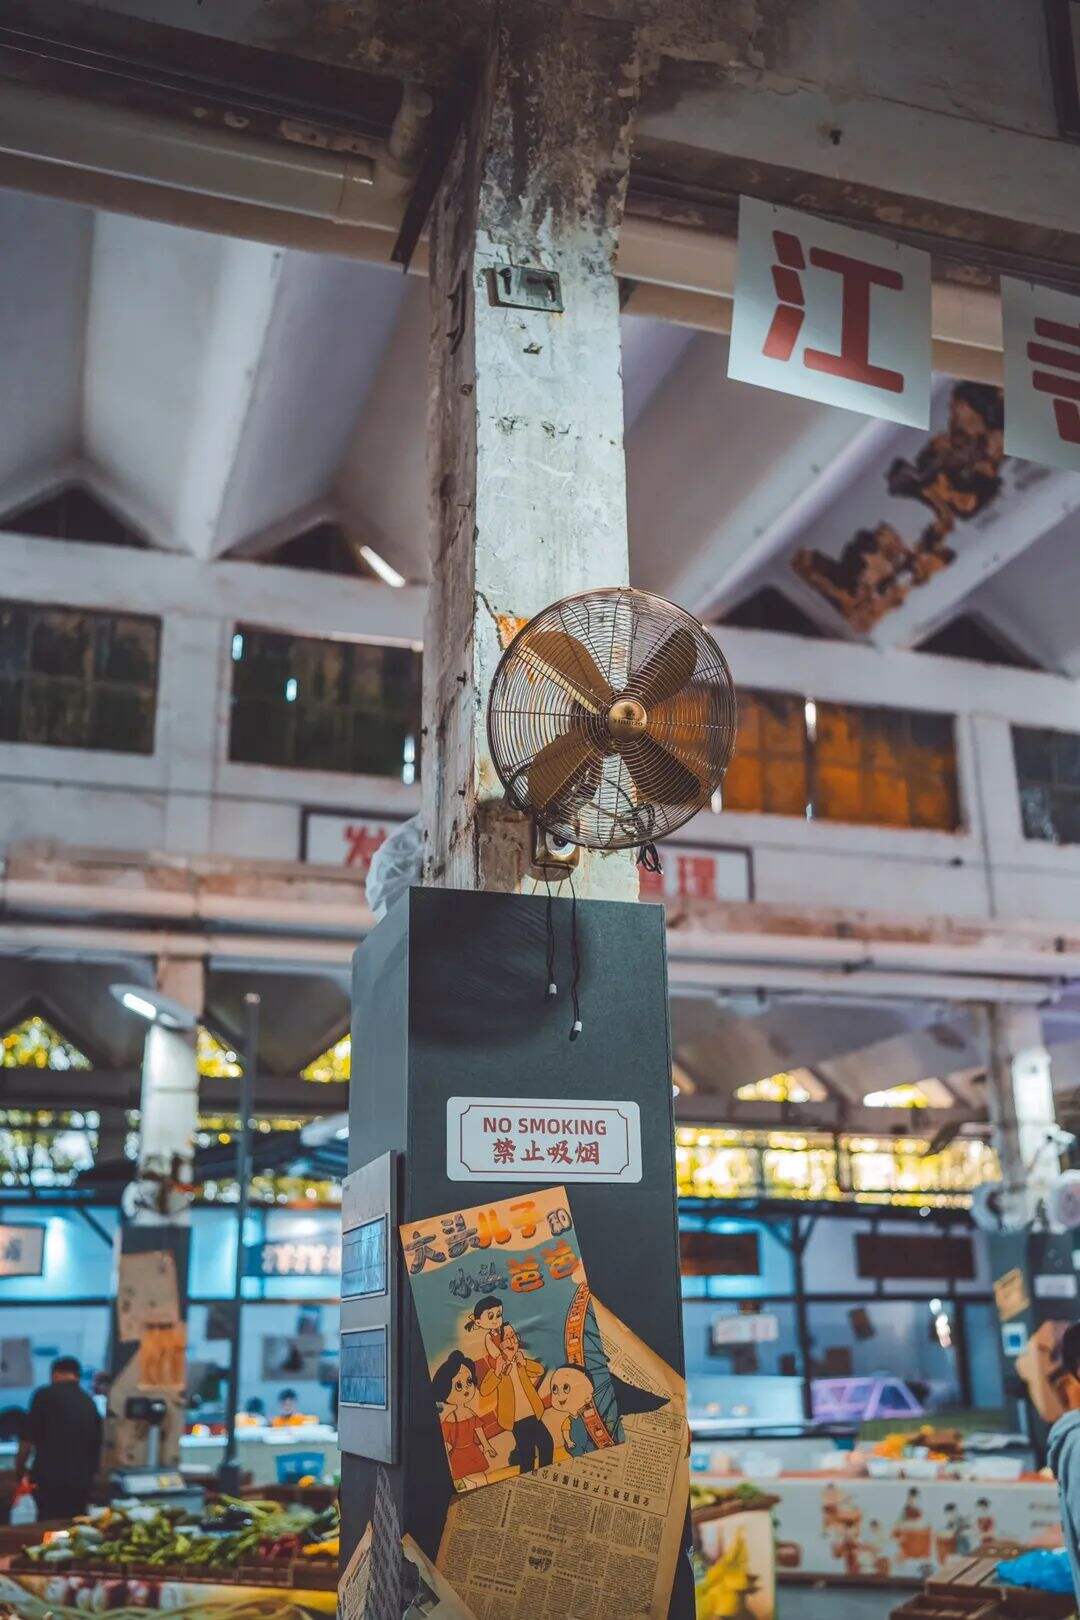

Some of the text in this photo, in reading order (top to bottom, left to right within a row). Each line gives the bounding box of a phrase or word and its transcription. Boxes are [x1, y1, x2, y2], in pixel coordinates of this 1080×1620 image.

[762, 230, 904, 394] 江
[483, 1117, 607, 1136] NO SMOKING
[492, 1137, 600, 1165] 禁止吸烟
